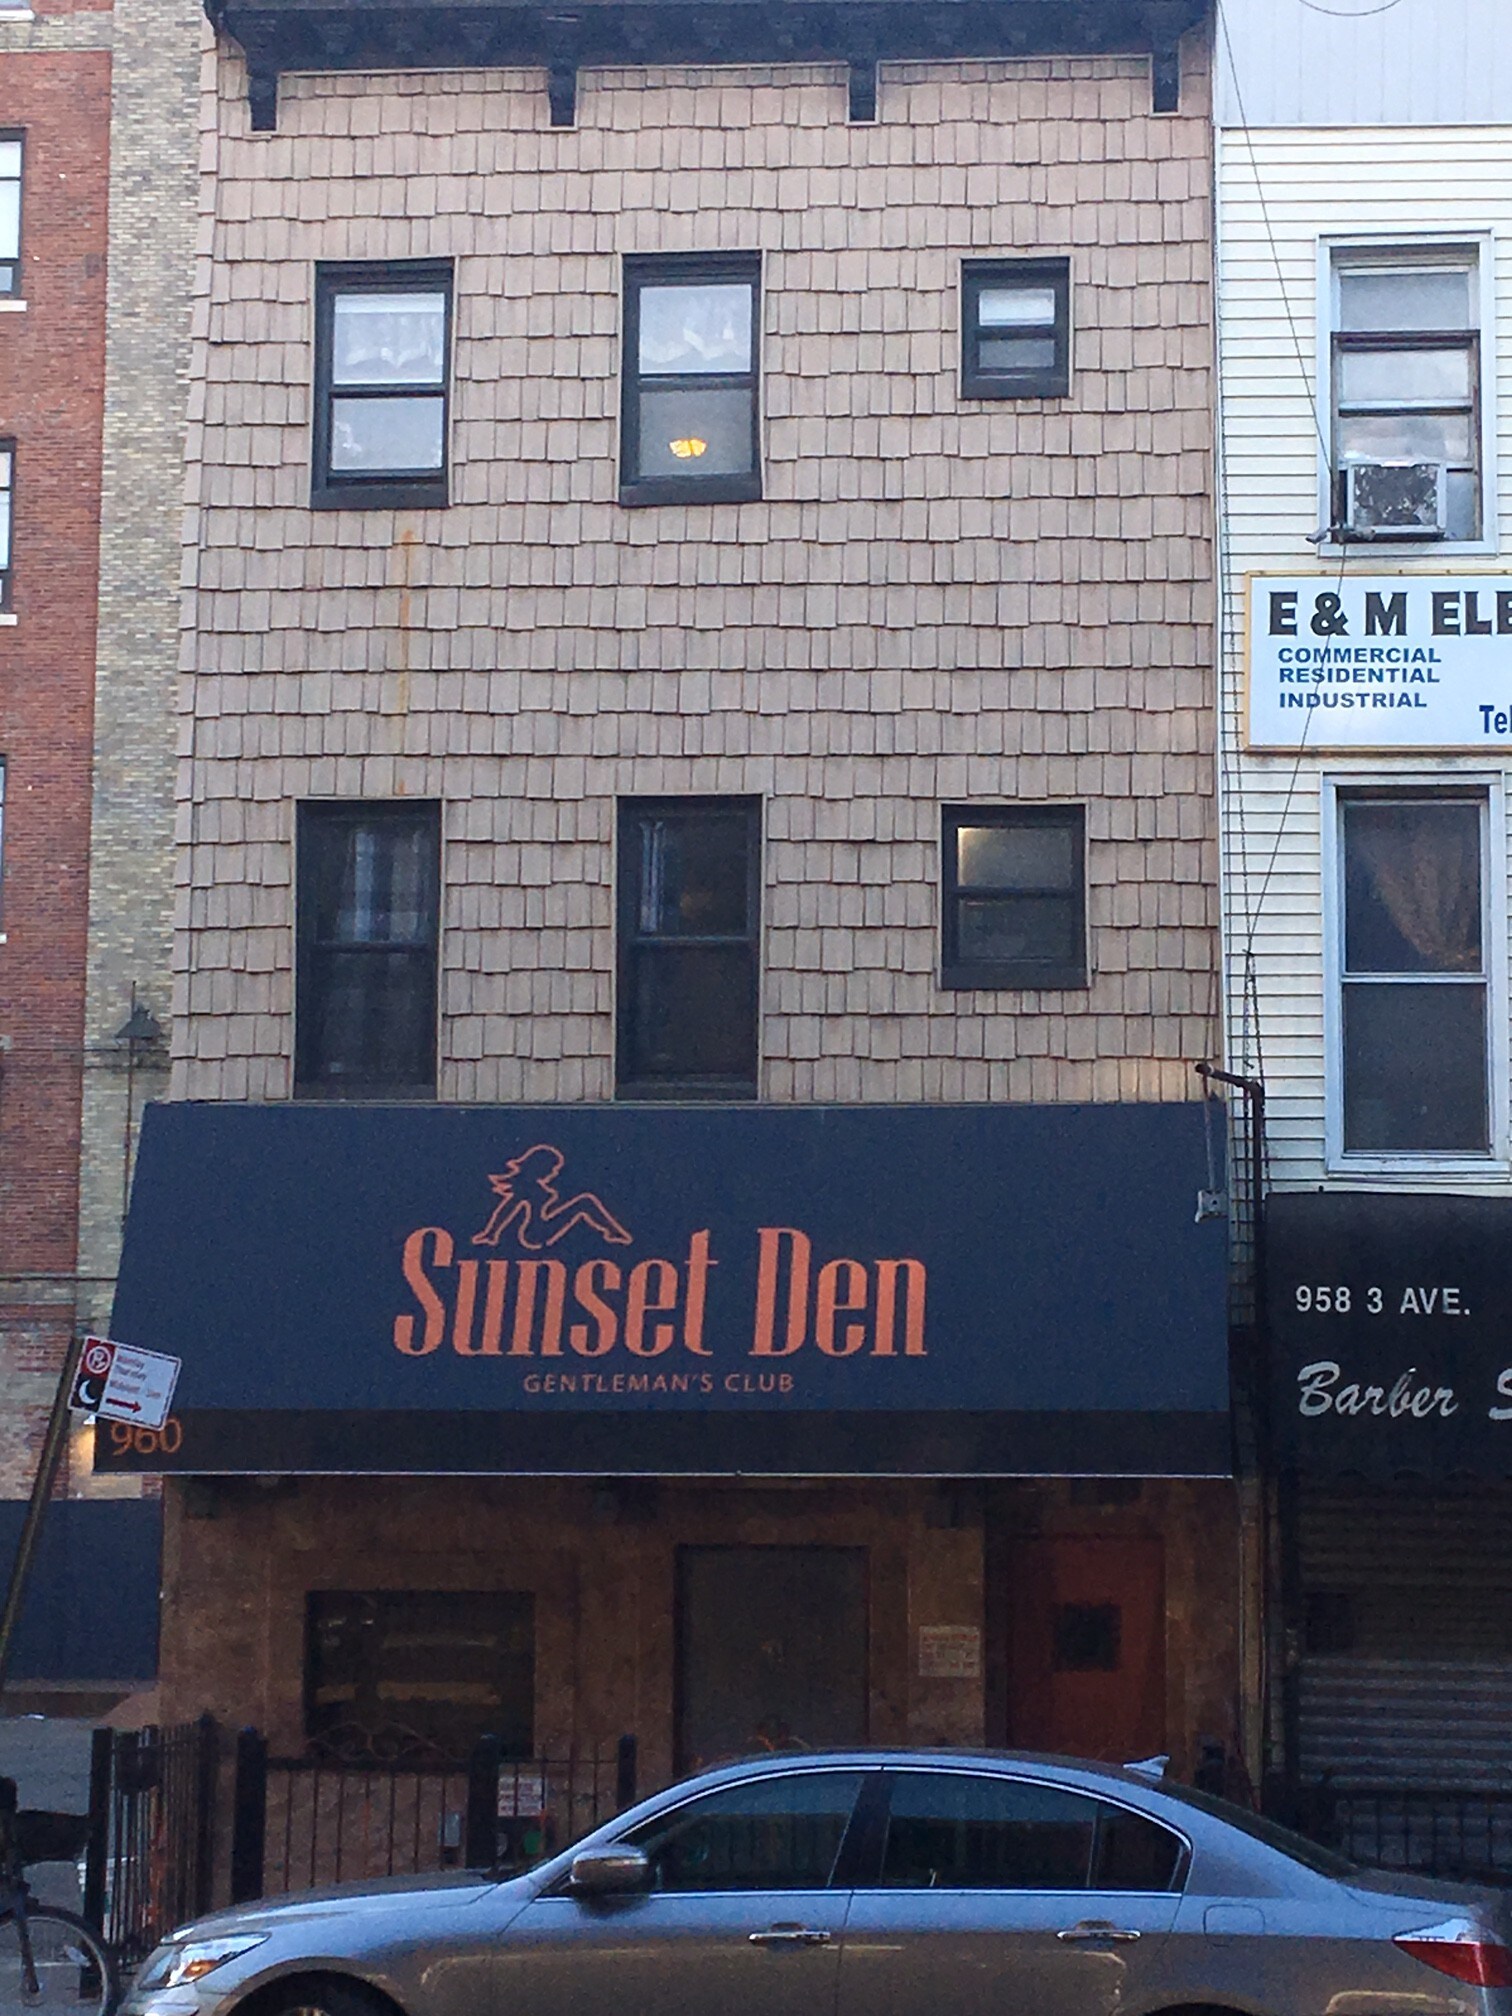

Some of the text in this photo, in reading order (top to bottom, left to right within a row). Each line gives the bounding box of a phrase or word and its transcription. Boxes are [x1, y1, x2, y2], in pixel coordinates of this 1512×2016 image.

[1278, 648, 1442, 663] COMMERCIAL
[1279, 668, 1440, 683] RESIDENTIAL
[1279, 693, 1427, 708] INDUSTRIAL
[394, 1227, 927, 1358] Sunset Den
[1296, 1285, 1470, 1315] 958 3 AVE.
[523, 1373, 795, 1393] GENTLEMAN'S CLUB
[1297, 1360, 1459, 1418] Barber
